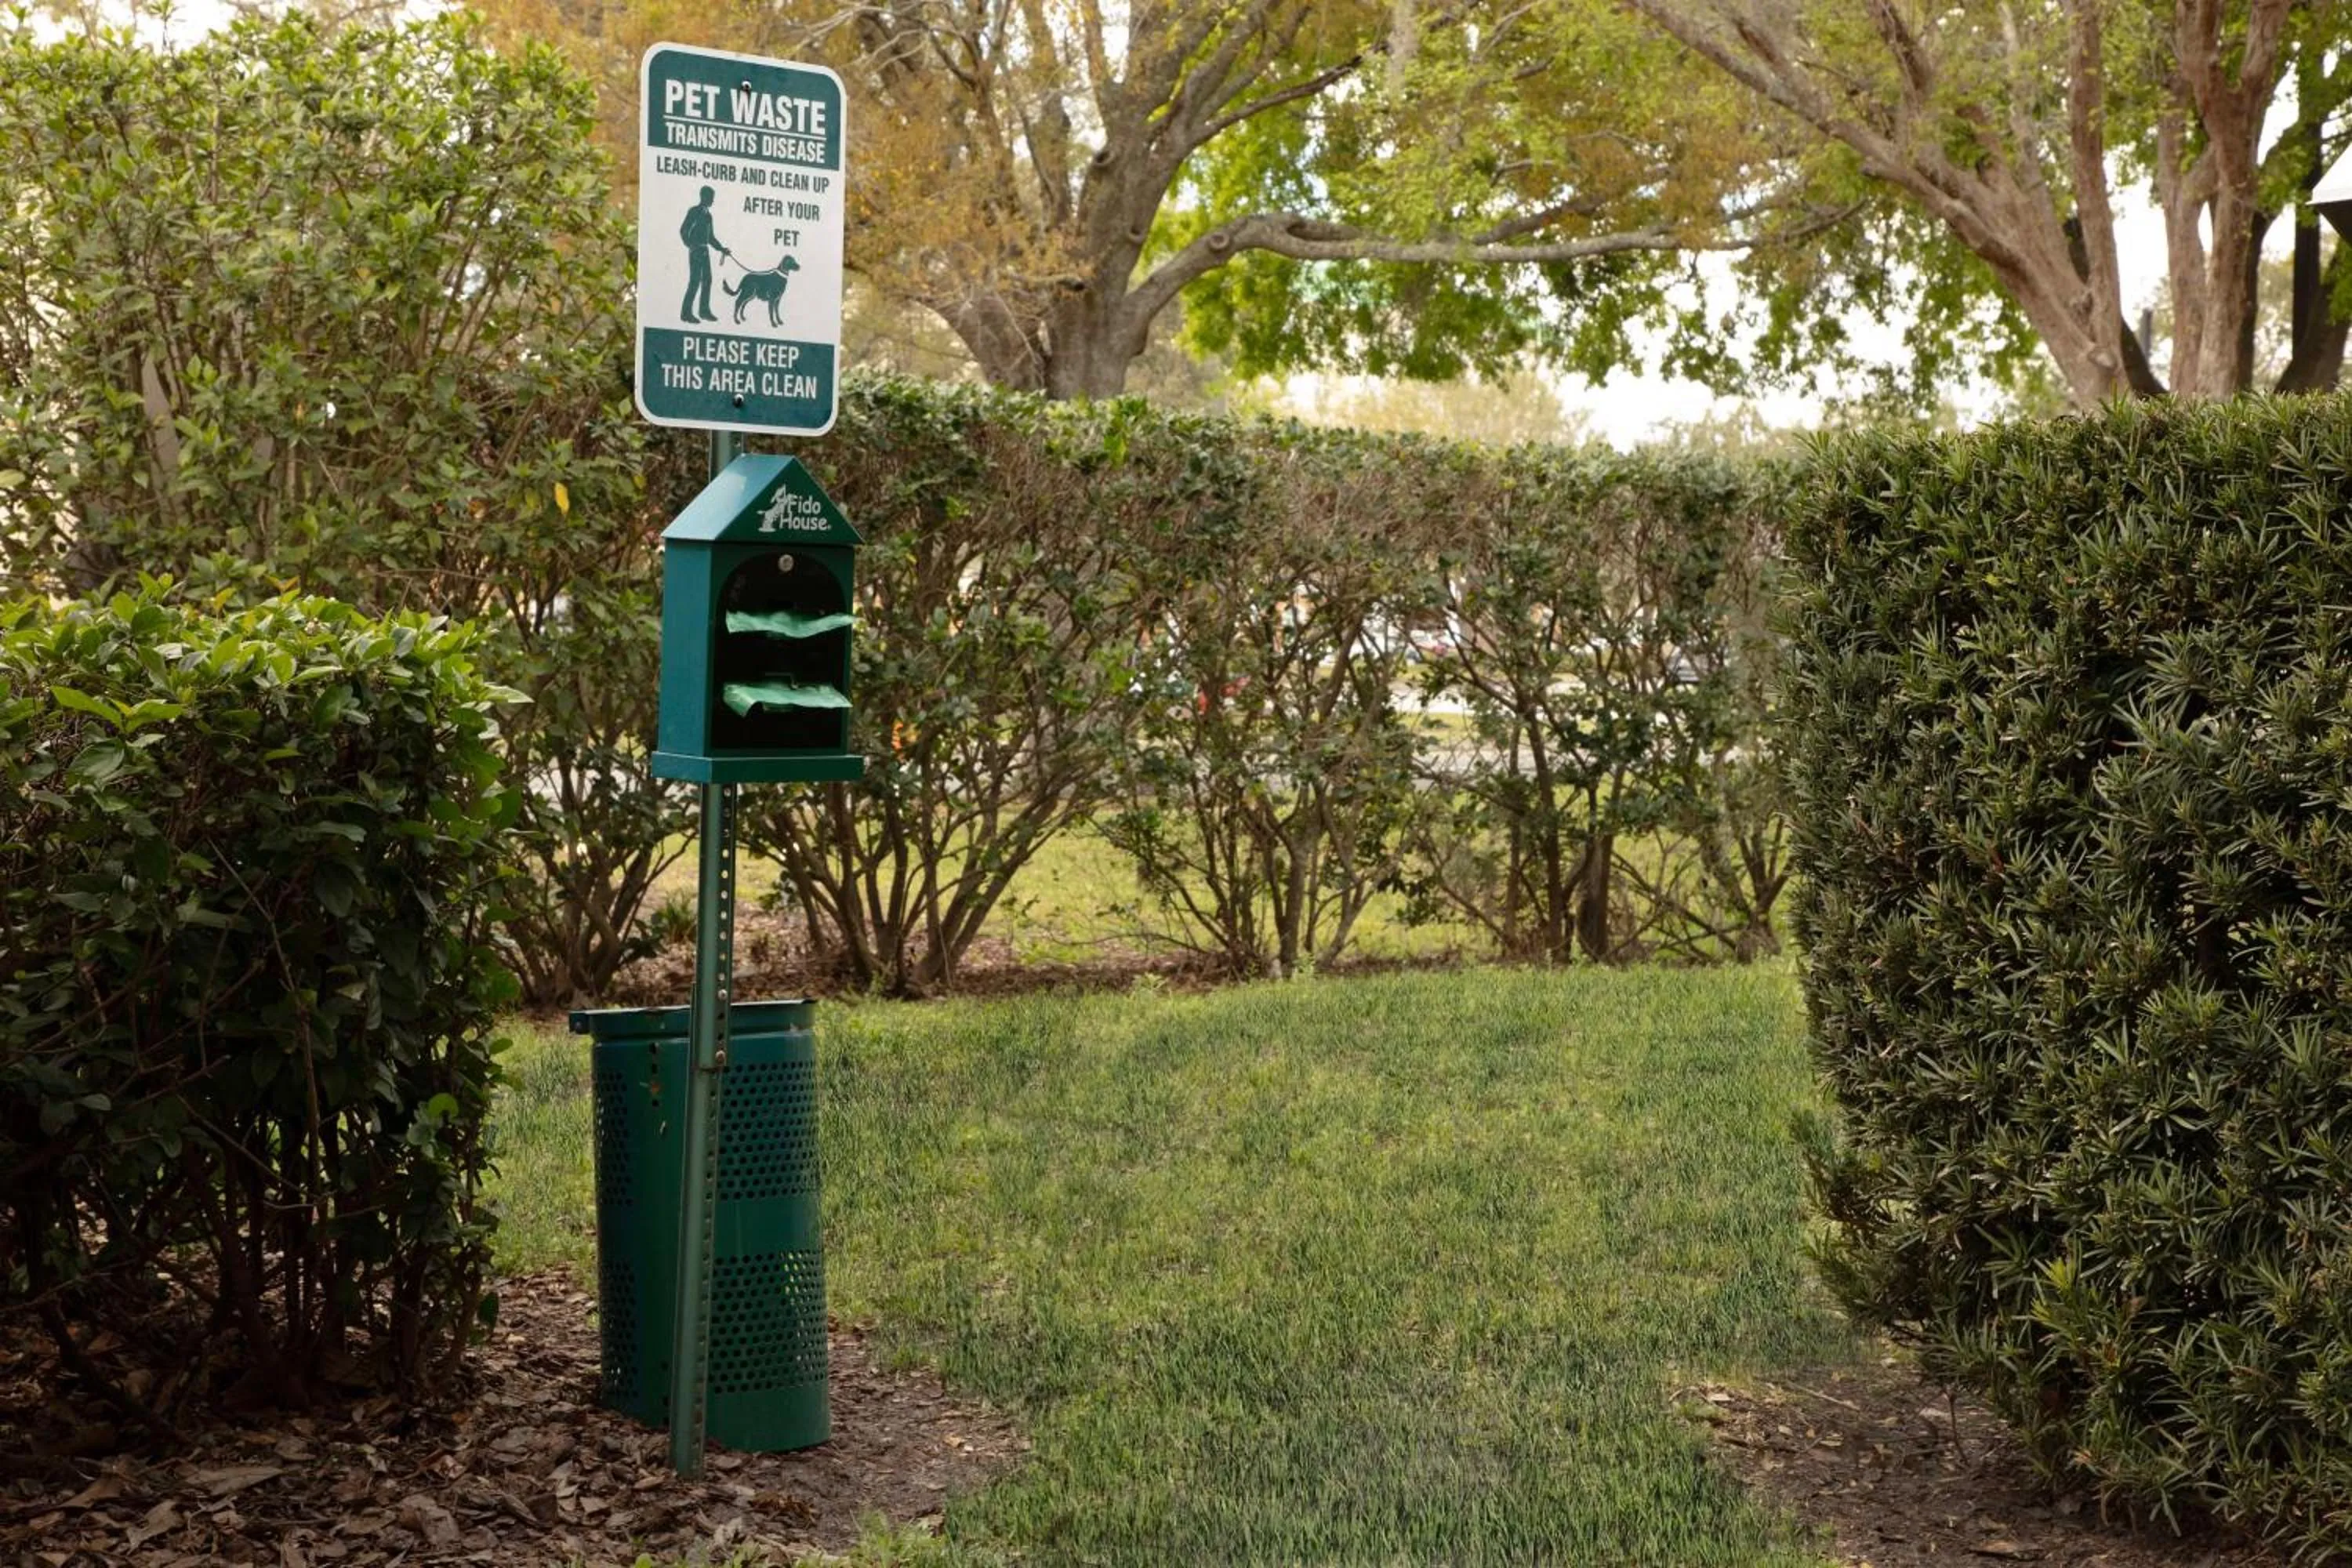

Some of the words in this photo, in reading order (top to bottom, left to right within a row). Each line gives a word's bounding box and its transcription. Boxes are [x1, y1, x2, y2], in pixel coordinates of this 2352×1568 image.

[666, 79, 720, 119] PET
[730, 88, 826, 134] WASTE
[665, 122, 757, 154] TRANSMITS
[762, 137, 826, 163] DISEASE
[656, 155, 736, 182] LEASH-CURB
[741, 168, 766, 186] AND
[771, 170, 809, 191] CLEAN
[813, 176, 829, 194] UP
[743, 196, 782, 216] AFTER
[787, 201, 820, 221] YOUR
[774, 229, 800, 247] PET
[683, 336, 750, 365] PLEASE
[756, 343, 800, 369] KEEP
[662, 364, 702, 390] THIS
[709, 368, 755, 394] AREA
[762, 372, 817, 400] CLEAN
[787, 494, 821, 514] Fido
